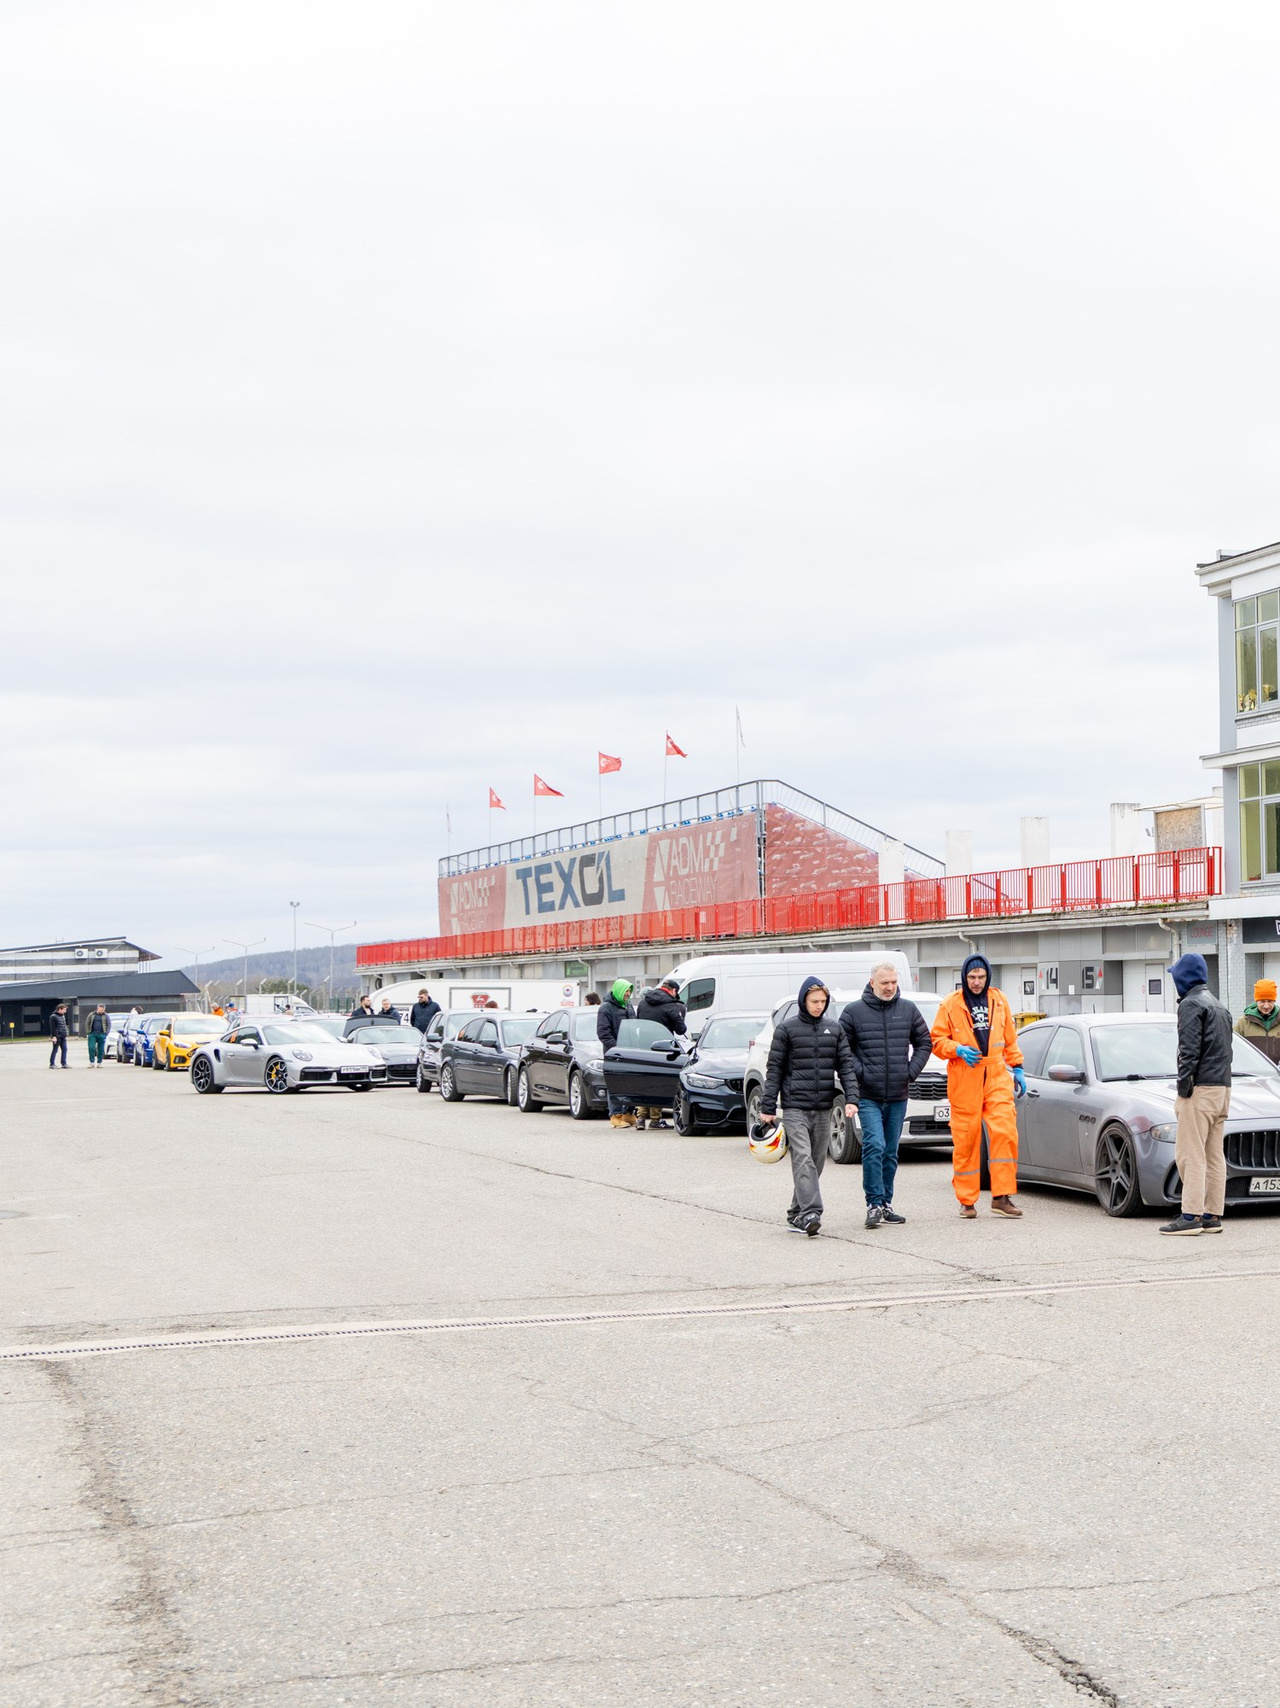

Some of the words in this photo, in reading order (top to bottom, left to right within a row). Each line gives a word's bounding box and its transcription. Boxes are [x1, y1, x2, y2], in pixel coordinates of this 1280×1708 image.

[670, 834, 705, 877] ADM
[516, 850, 626, 915] TEXOL
[670, 873, 718, 904] RACEWAY
[1191, 926, 1214, 938] LOUNGE
[1046, 967, 1059, 989] 14
[1082, 967, 1094, 989] 15
